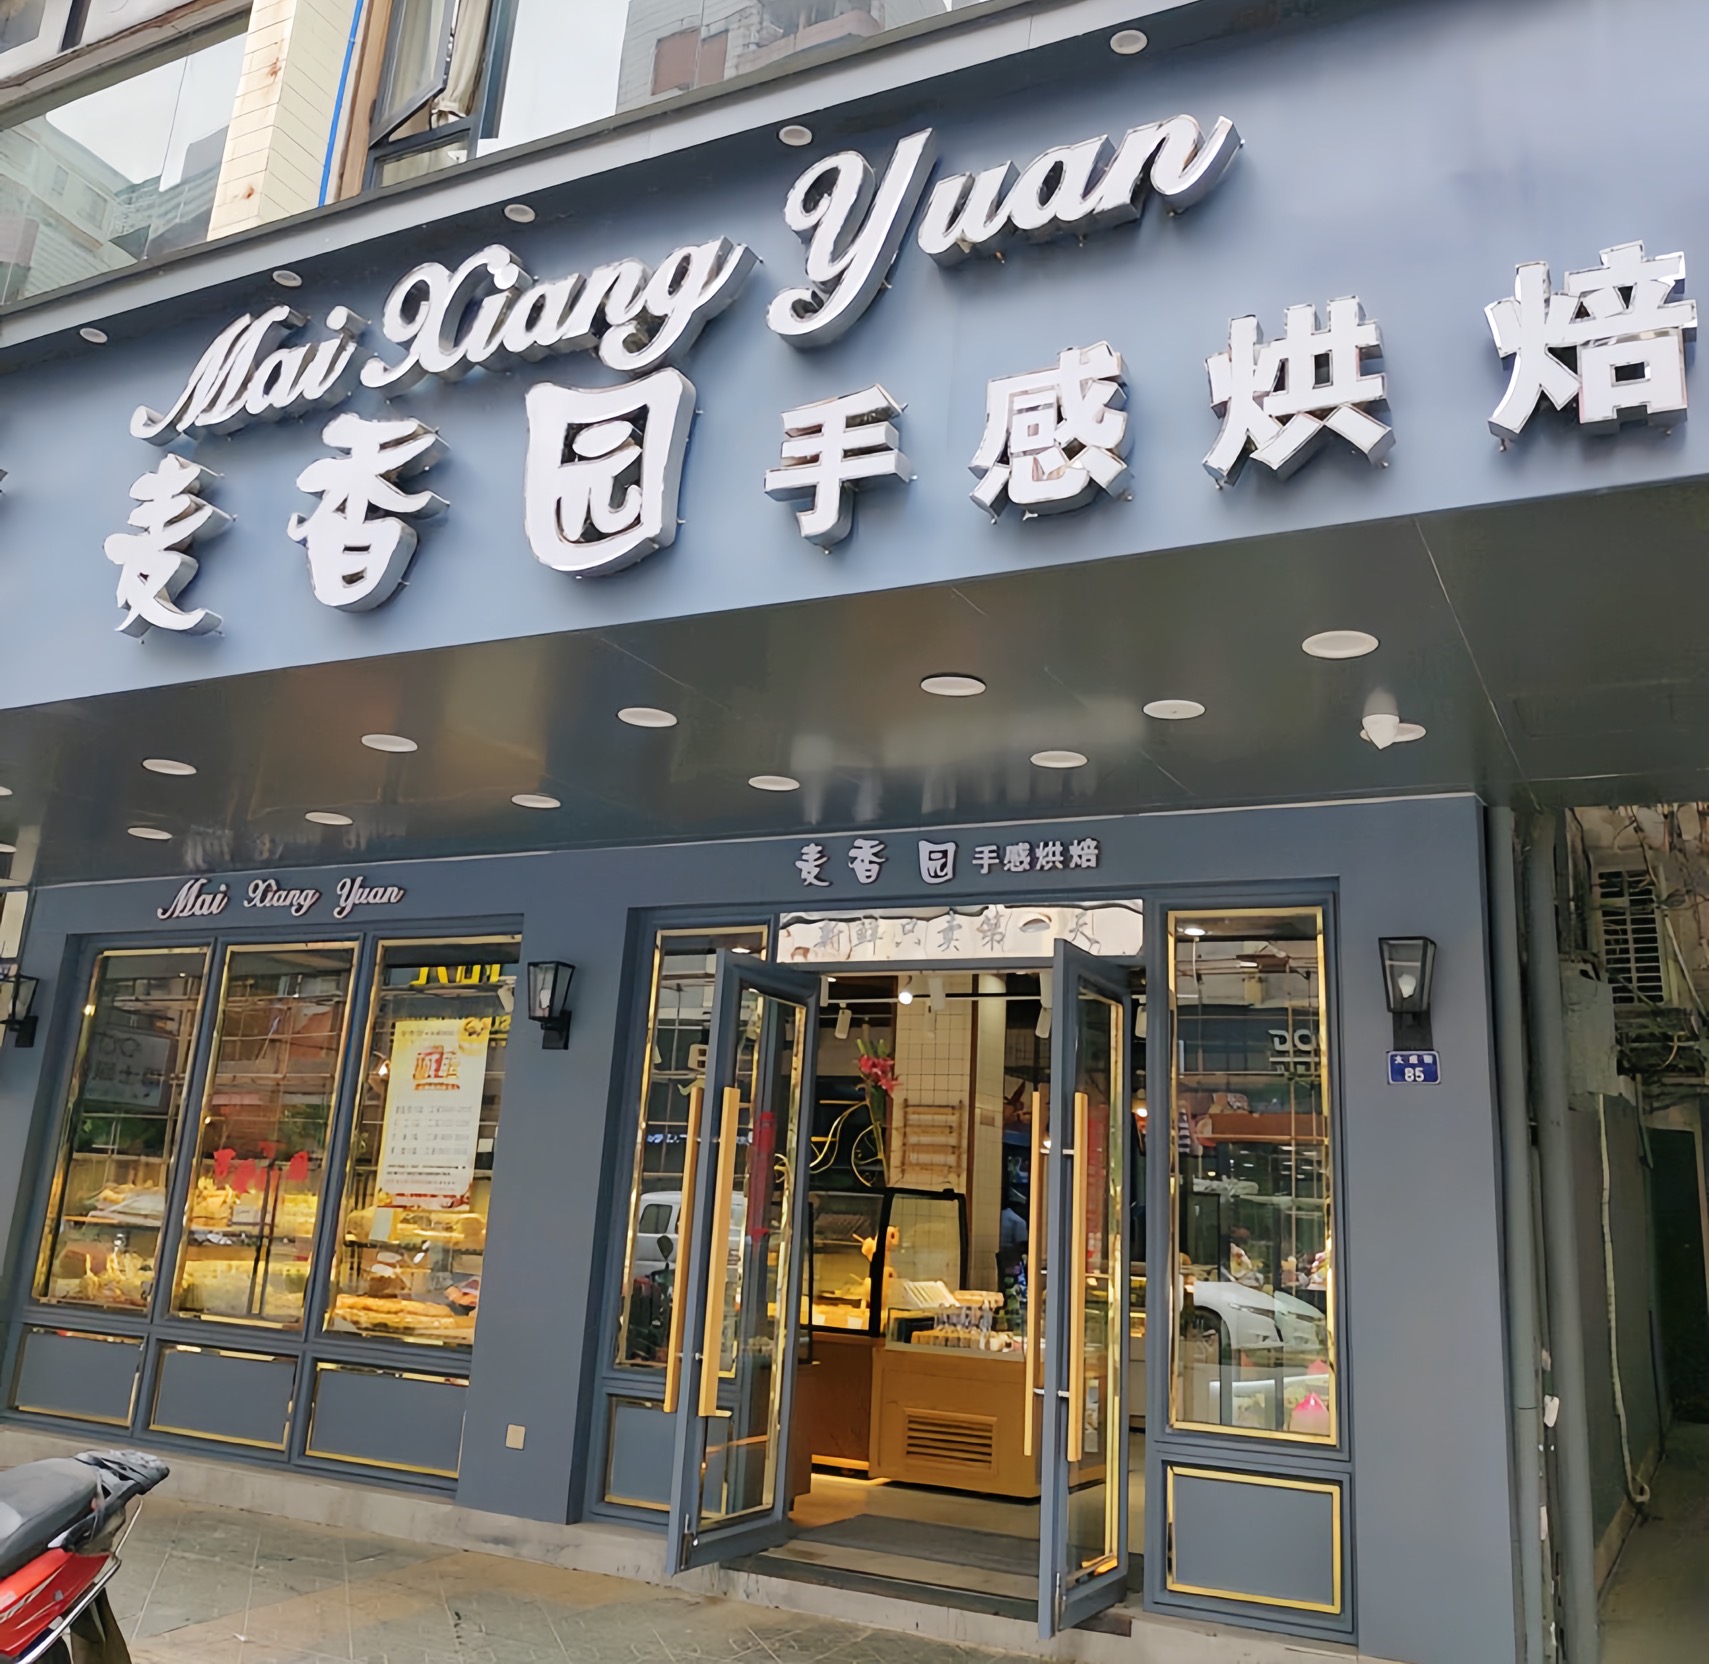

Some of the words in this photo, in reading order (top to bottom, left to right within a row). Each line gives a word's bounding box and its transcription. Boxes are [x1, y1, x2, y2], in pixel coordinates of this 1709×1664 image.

[131, 304, 366, 446] Mai
[360, 243, 757, 394] Xiang
[766, 113, 1241, 348] Yuan
[104, 367, 697, 638] 麦香园
[764, 240, 1697, 547] 手感烘焙
[794, 838, 958, 887] 麦香园
[971, 837, 1100, 875] 手感烘焙
[157, 878, 228, 920] Mai
[243, 879, 321, 917] Xiang
[332, 875, 405, 919] Yuan
[1404, 1067, 1425, 1082] 85
